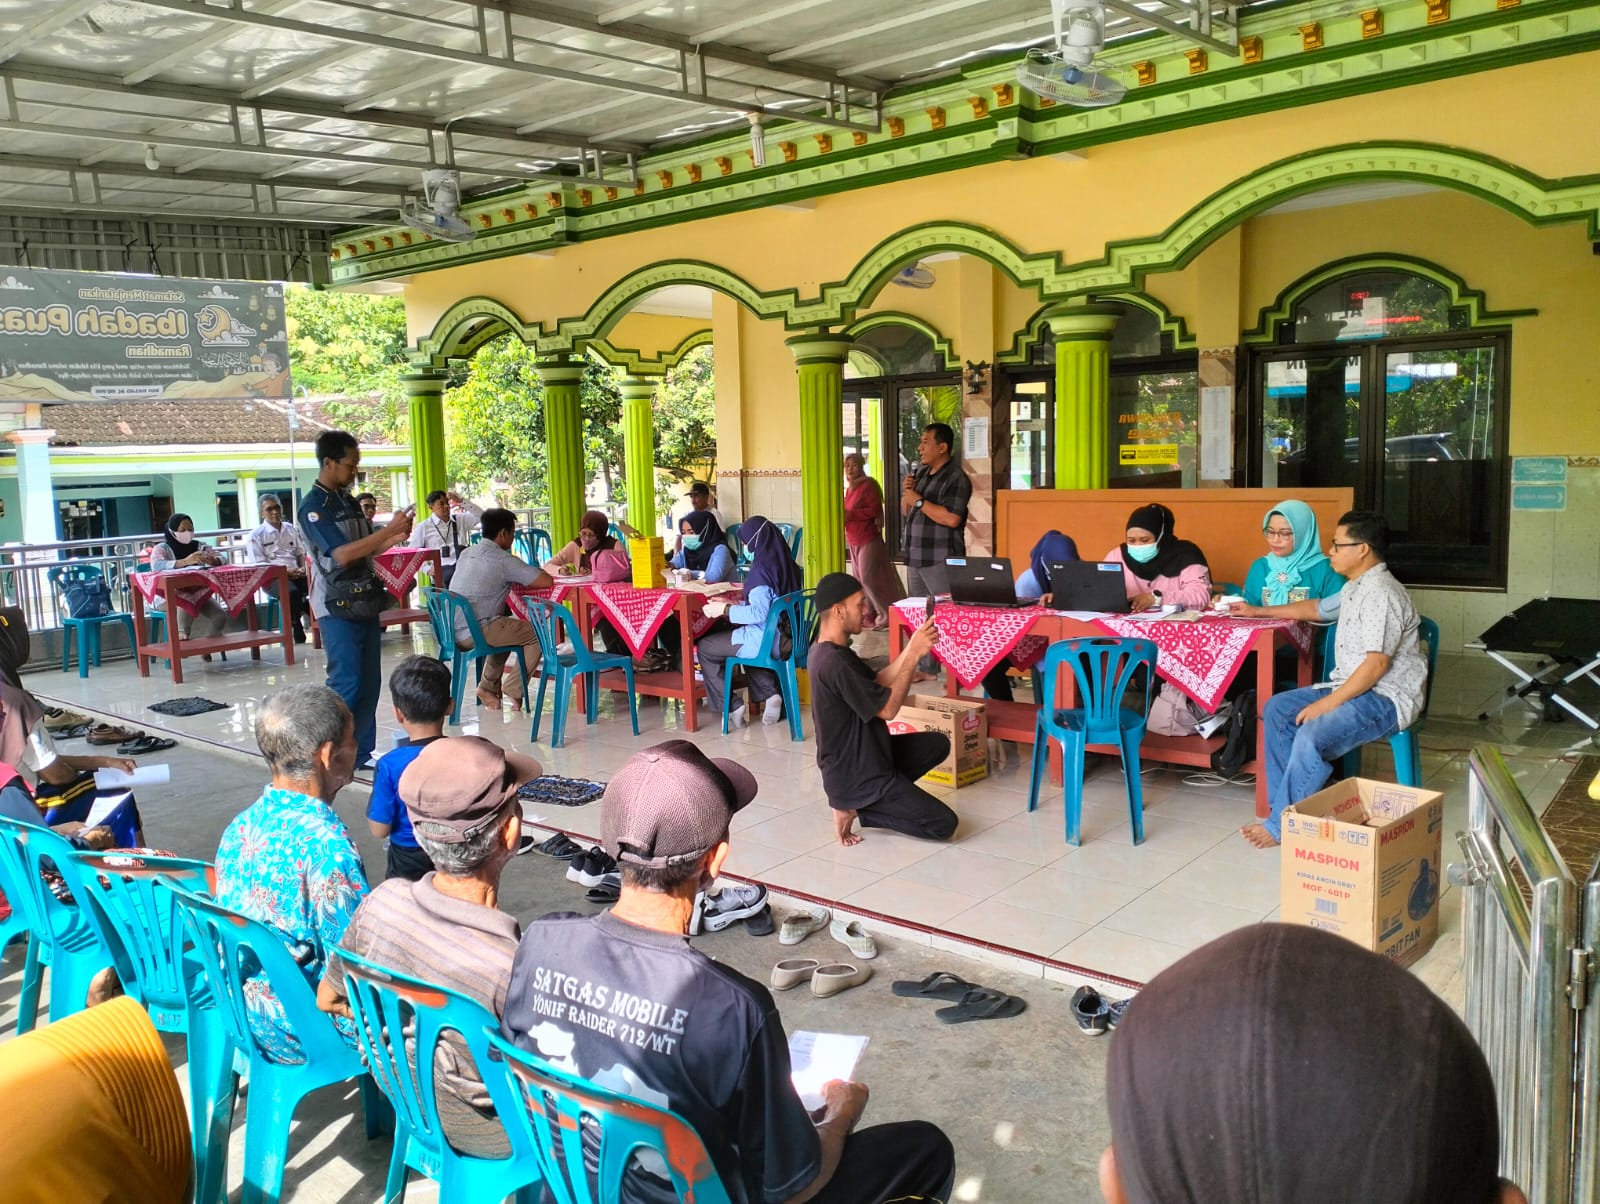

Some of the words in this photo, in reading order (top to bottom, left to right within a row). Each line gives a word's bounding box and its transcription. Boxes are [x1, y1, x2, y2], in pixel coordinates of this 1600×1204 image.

[1380, 817, 1416, 846] MASPION
[1294, 847, 1360, 872] MASPION
[1405, 926, 1421, 946] FAN
[532, 966, 609, 1010] SATGAS
[610, 990, 689, 1035] MOBILE
[532, 993, 566, 1020] YONIF
[568, 1003, 616, 1036] RAIDER
[619, 1023, 677, 1057] 712/WT
